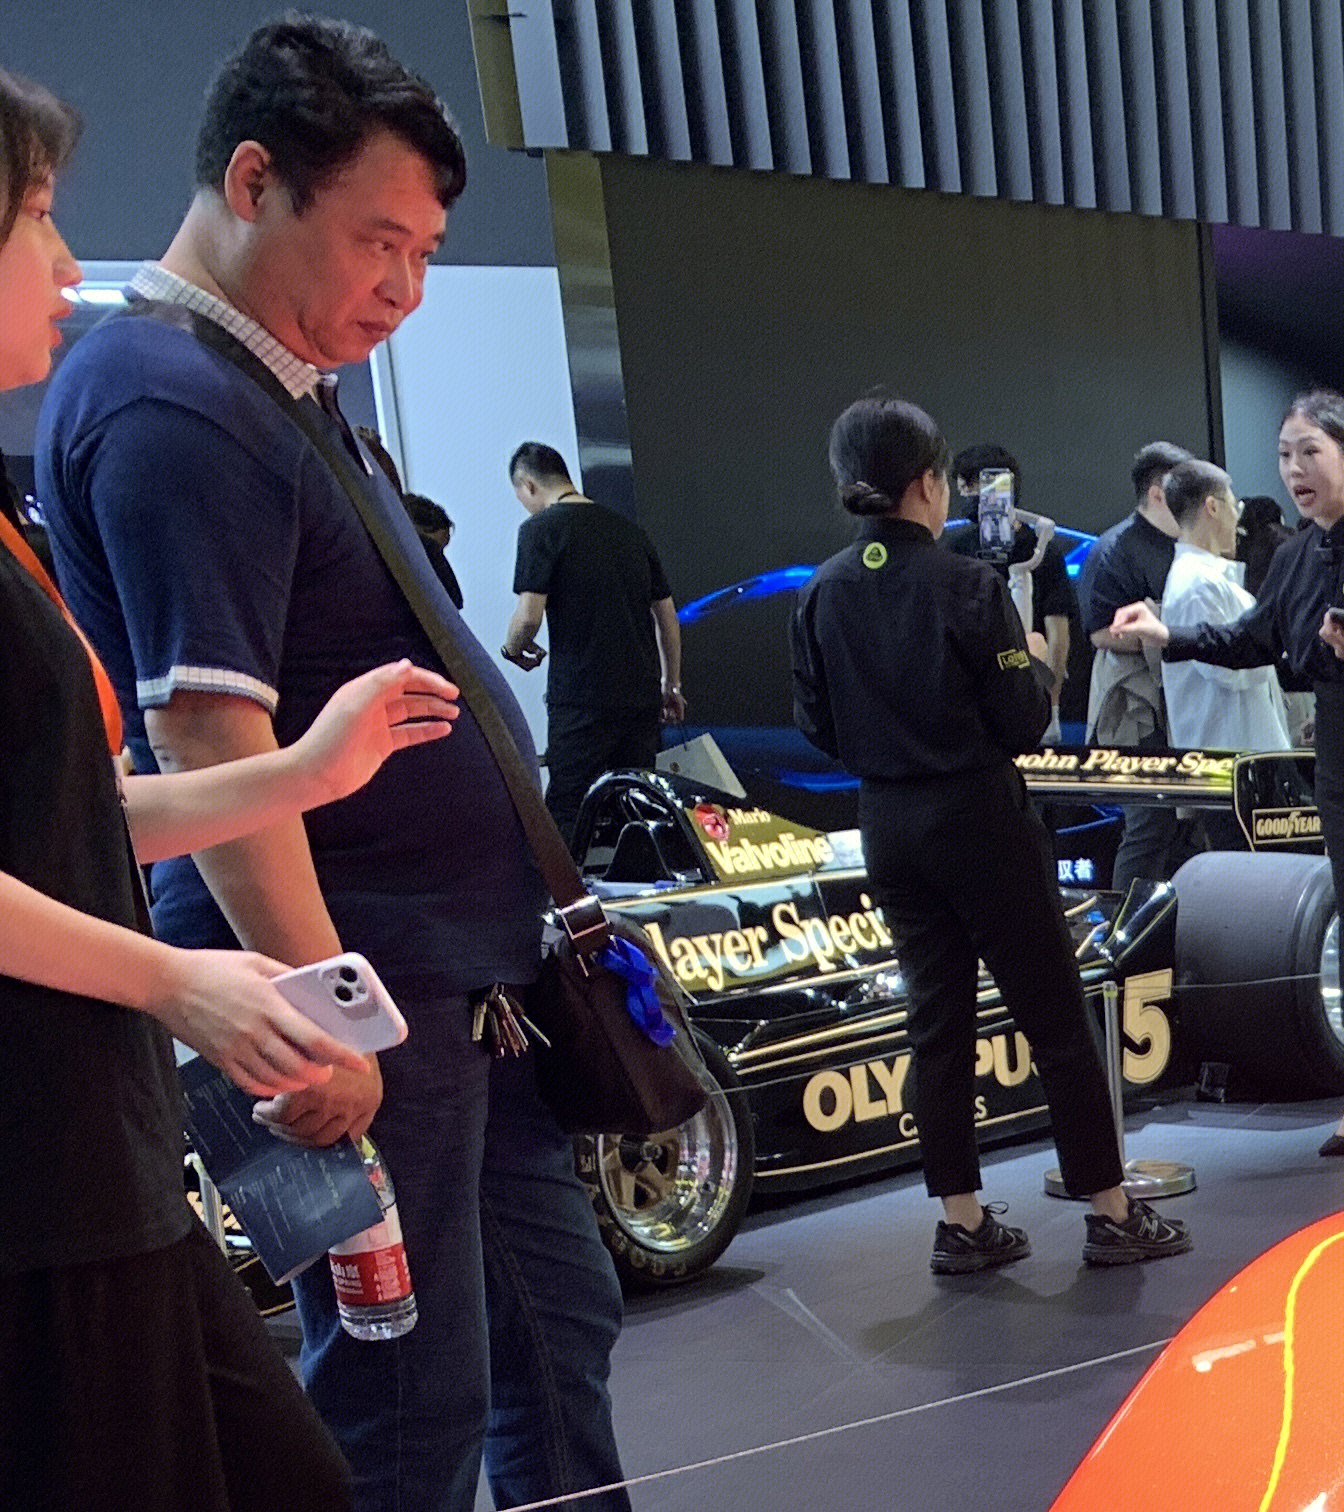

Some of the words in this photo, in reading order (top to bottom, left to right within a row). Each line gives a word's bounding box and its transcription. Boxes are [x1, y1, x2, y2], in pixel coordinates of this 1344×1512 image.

[1012, 748, 1078, 770] ohn
[1080, 749, 1177, 774] Player
[727, 807, 771, 825] Mario
[705, 832, 834, 875] Valvoline
[1122, 968, 1173, 1084] 5
